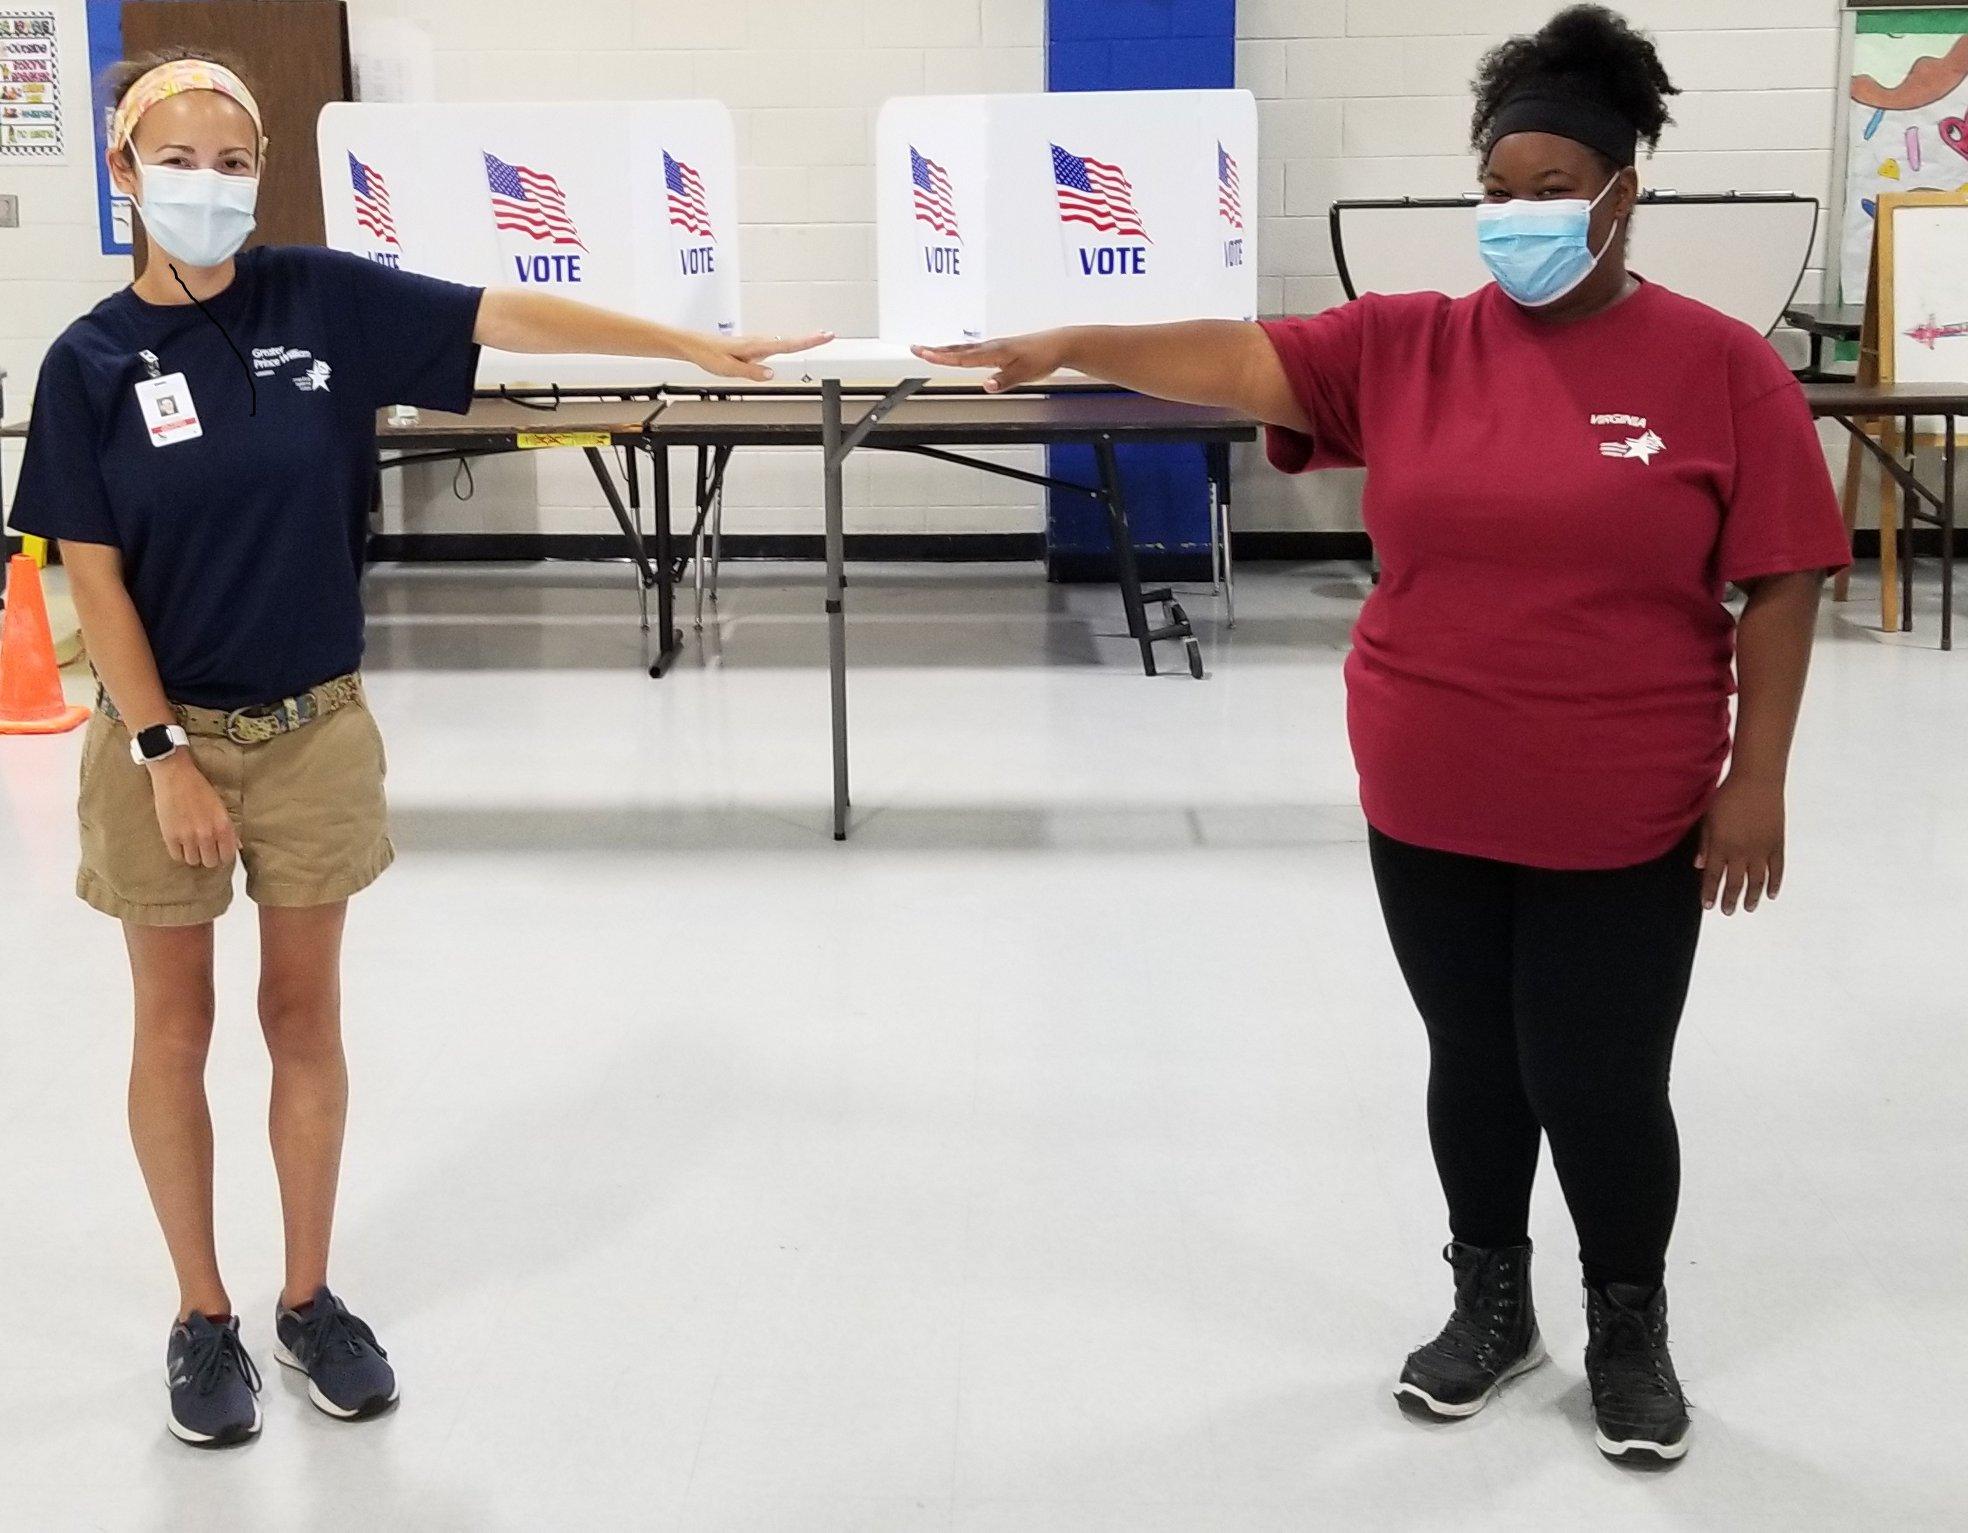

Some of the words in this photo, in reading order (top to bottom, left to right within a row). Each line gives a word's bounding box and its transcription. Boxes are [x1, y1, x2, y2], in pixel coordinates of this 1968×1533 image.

[514, 254, 581, 282] VOTE
[680, 246, 715, 275] VOTE
[924, 246, 961, 275] VOTE
[1079, 246, 1146, 275] VOTE
[1589, 413, 1647, 428] VIRGINIA
